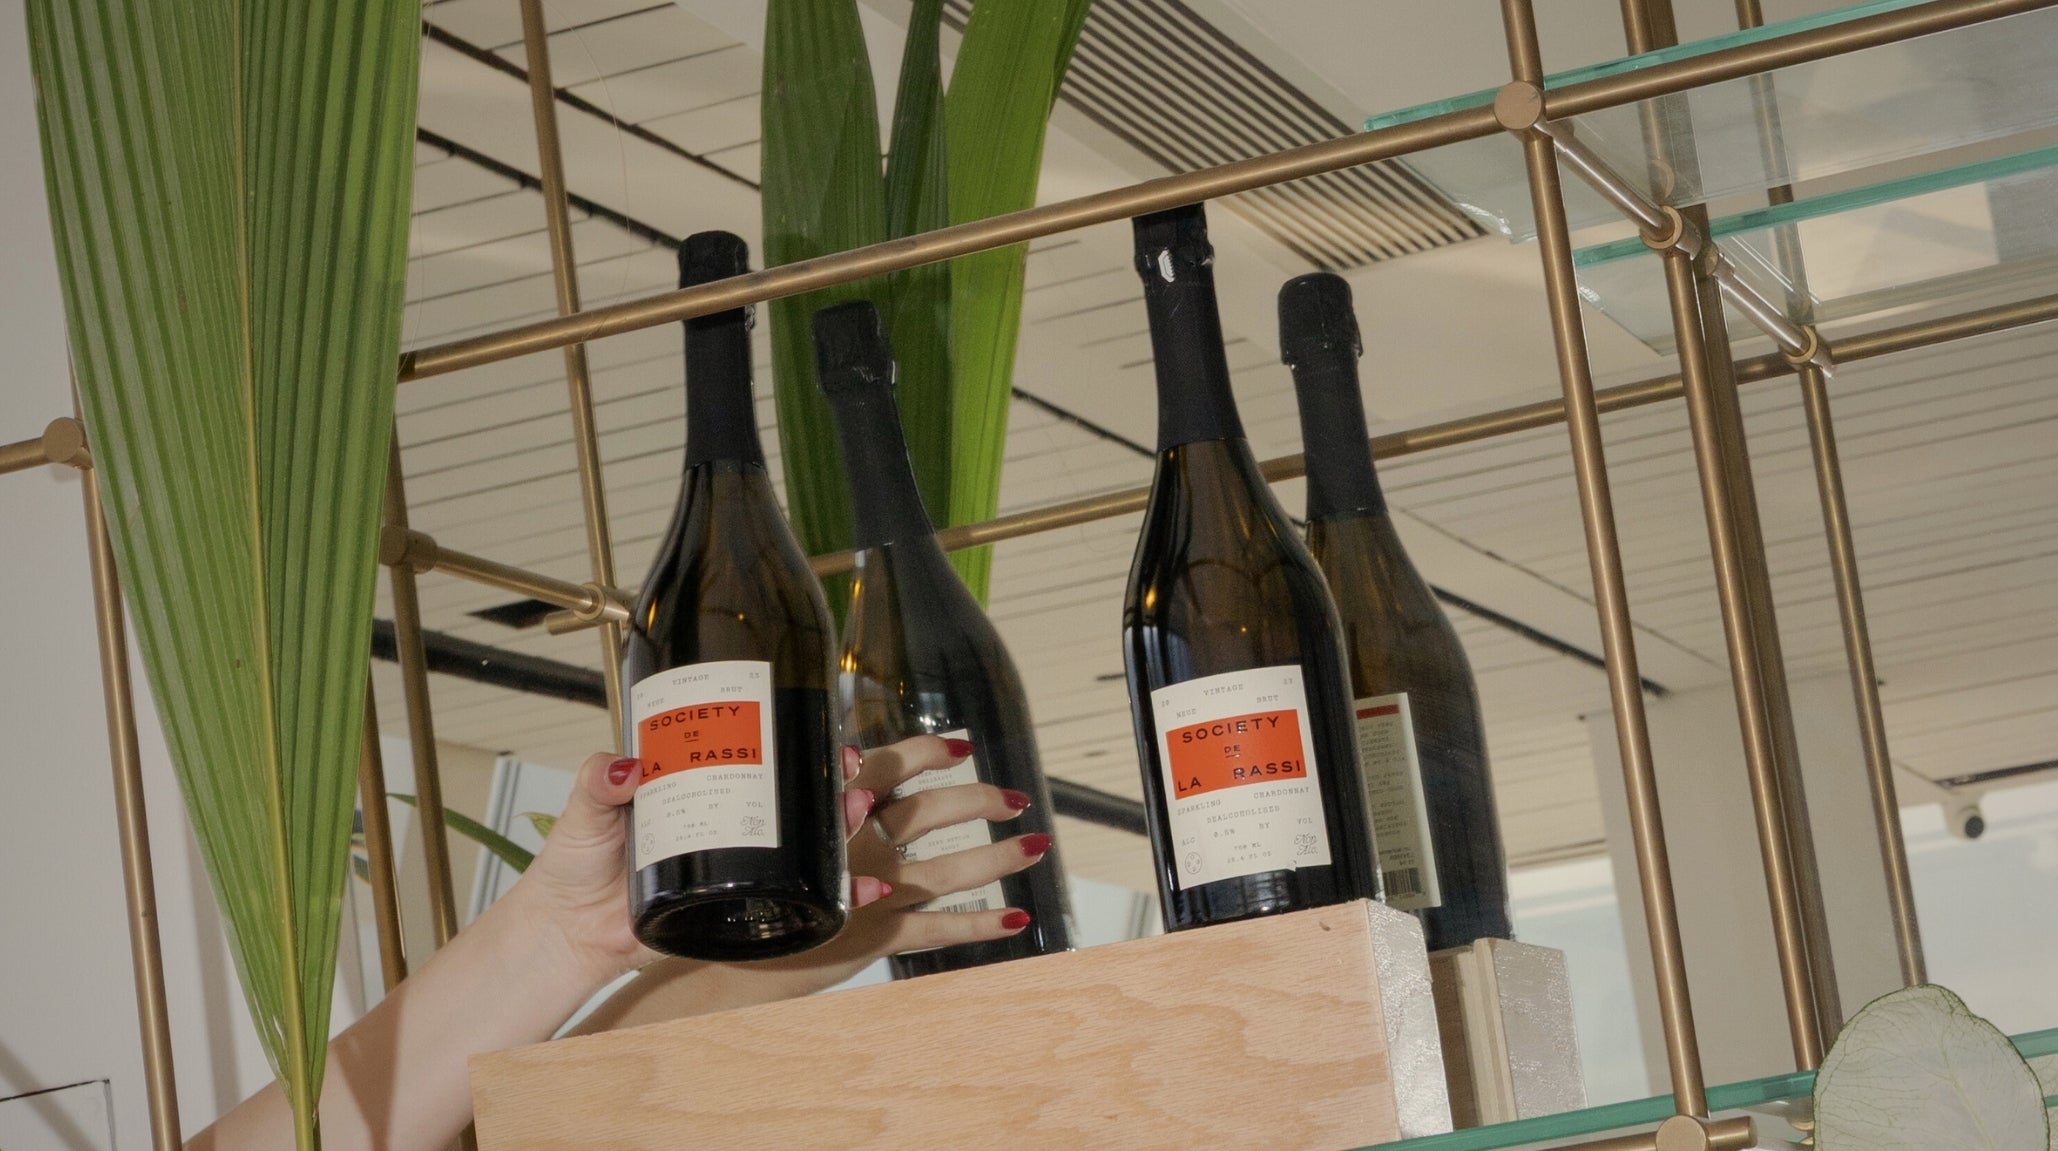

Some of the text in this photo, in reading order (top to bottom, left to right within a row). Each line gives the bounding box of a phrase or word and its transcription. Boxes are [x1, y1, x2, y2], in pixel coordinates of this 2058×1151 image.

[673, 674, 710, 685] VINTAGE
[1203, 684, 1244, 696] VINTAGE
[1256, 695, 1279, 703] BRUT
[650, 706, 741, 731] SOCIETY
[684, 731, 699, 739] DE
[1182, 716, 1279, 743] SOCIETY
[1224, 744, 1240, 753] DE
[642, 748, 757, 778] LA RASSI
[706, 773, 763, 782] CHARDONNAY
[1178, 760, 1301, 792] LA RASSI
[1253, 787, 1310, 799] CHARDONNAY
